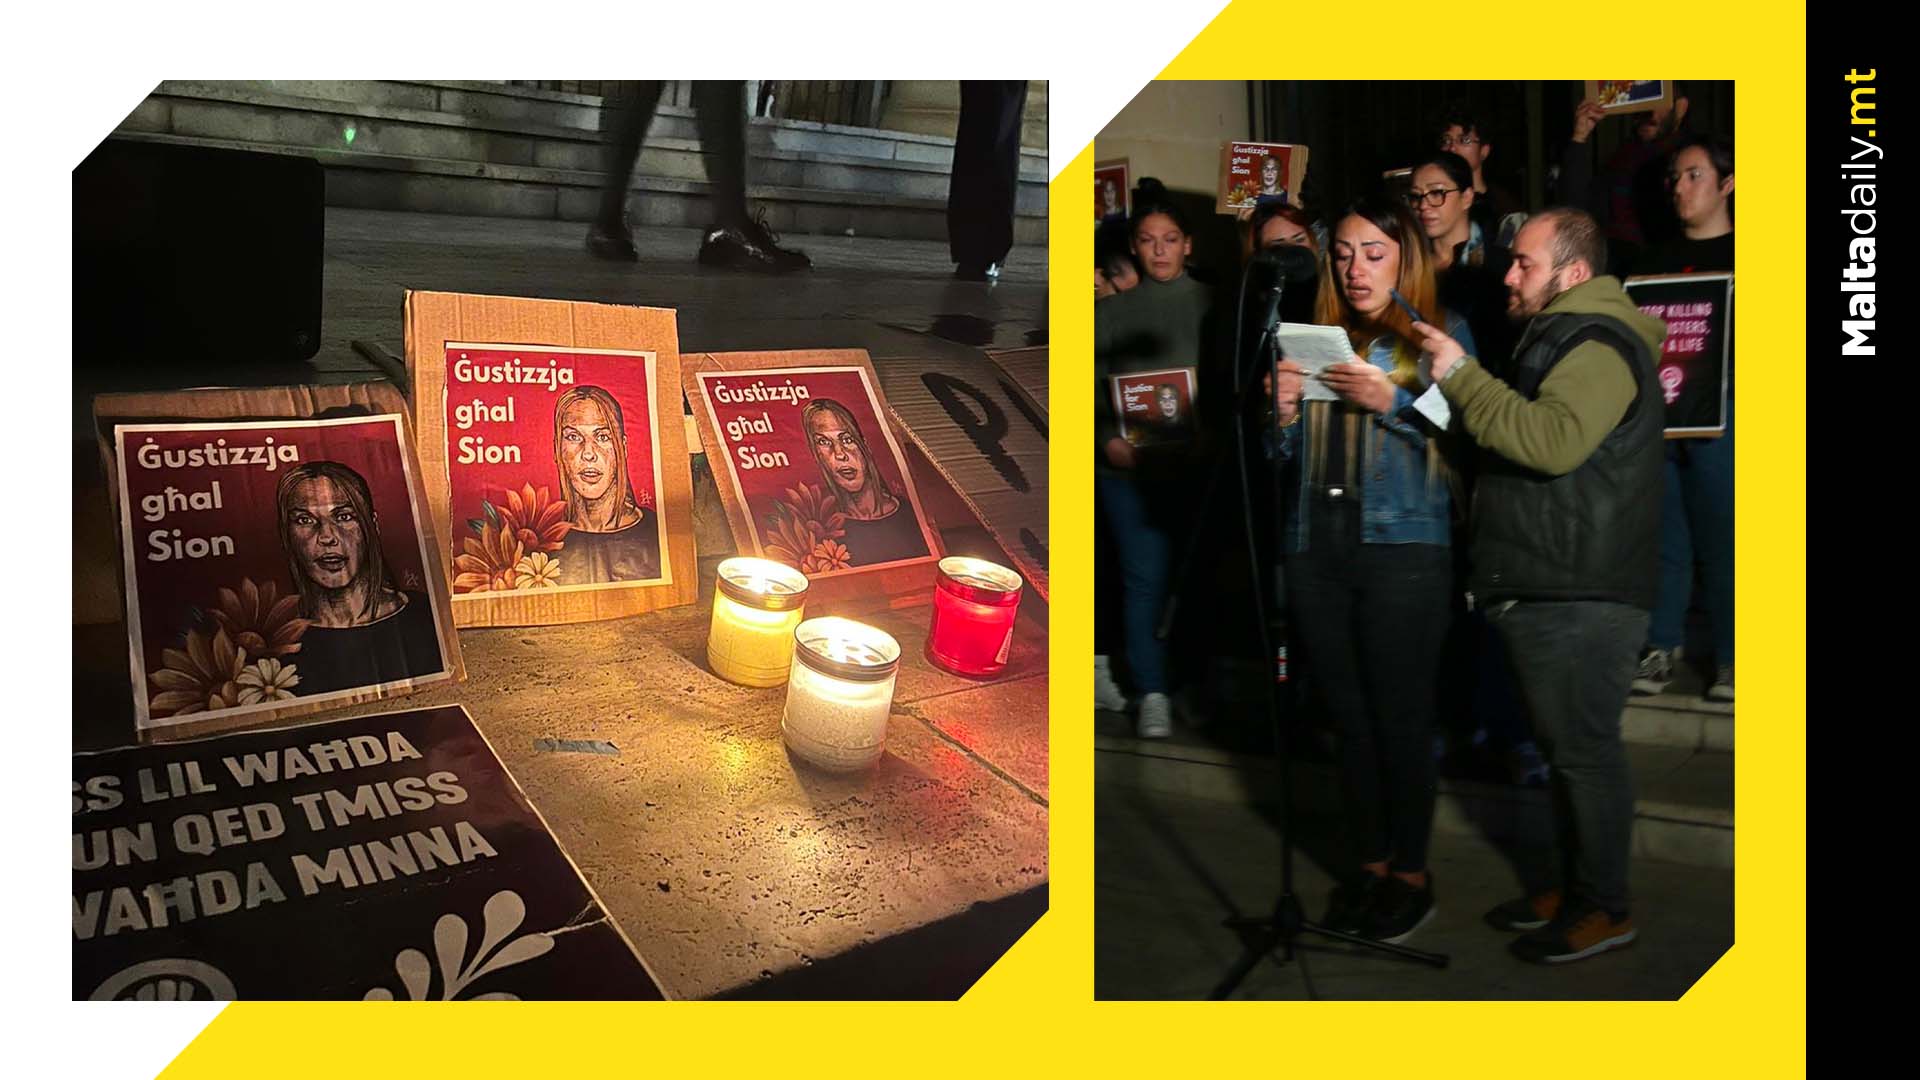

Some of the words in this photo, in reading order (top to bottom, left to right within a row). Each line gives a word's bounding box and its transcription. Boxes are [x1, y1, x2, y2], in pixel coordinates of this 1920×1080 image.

[1666, 303, 1712, 317] KILLING
[1667, 320, 1711, 335] ISTERS,
[1678, 337, 1704, 352] LIFE
[454, 353, 574, 391] Ġustizzja
[714, 379, 810, 405] Ġustizzja
[1123, 384, 1154, 394] Justice
[1125, 394, 1139, 402] for
[455, 397, 515, 429] għal
[1127, 403, 1149, 412] Sion
[726, 413, 774, 442] għal
[137, 436, 300, 472] Ġustizzja
[457, 436, 521, 464] Sion
[737, 446, 790, 470] Sion
[141, 481, 223, 522] għal
[147, 529, 235, 562] Sion
[138, 761, 217, 803] LIL
[222, 732, 424, 788] WAĦDA
[172, 802, 286, 856] QED
[292, 770, 469, 831] TMISS
[291, 820, 499, 896] MINNA
